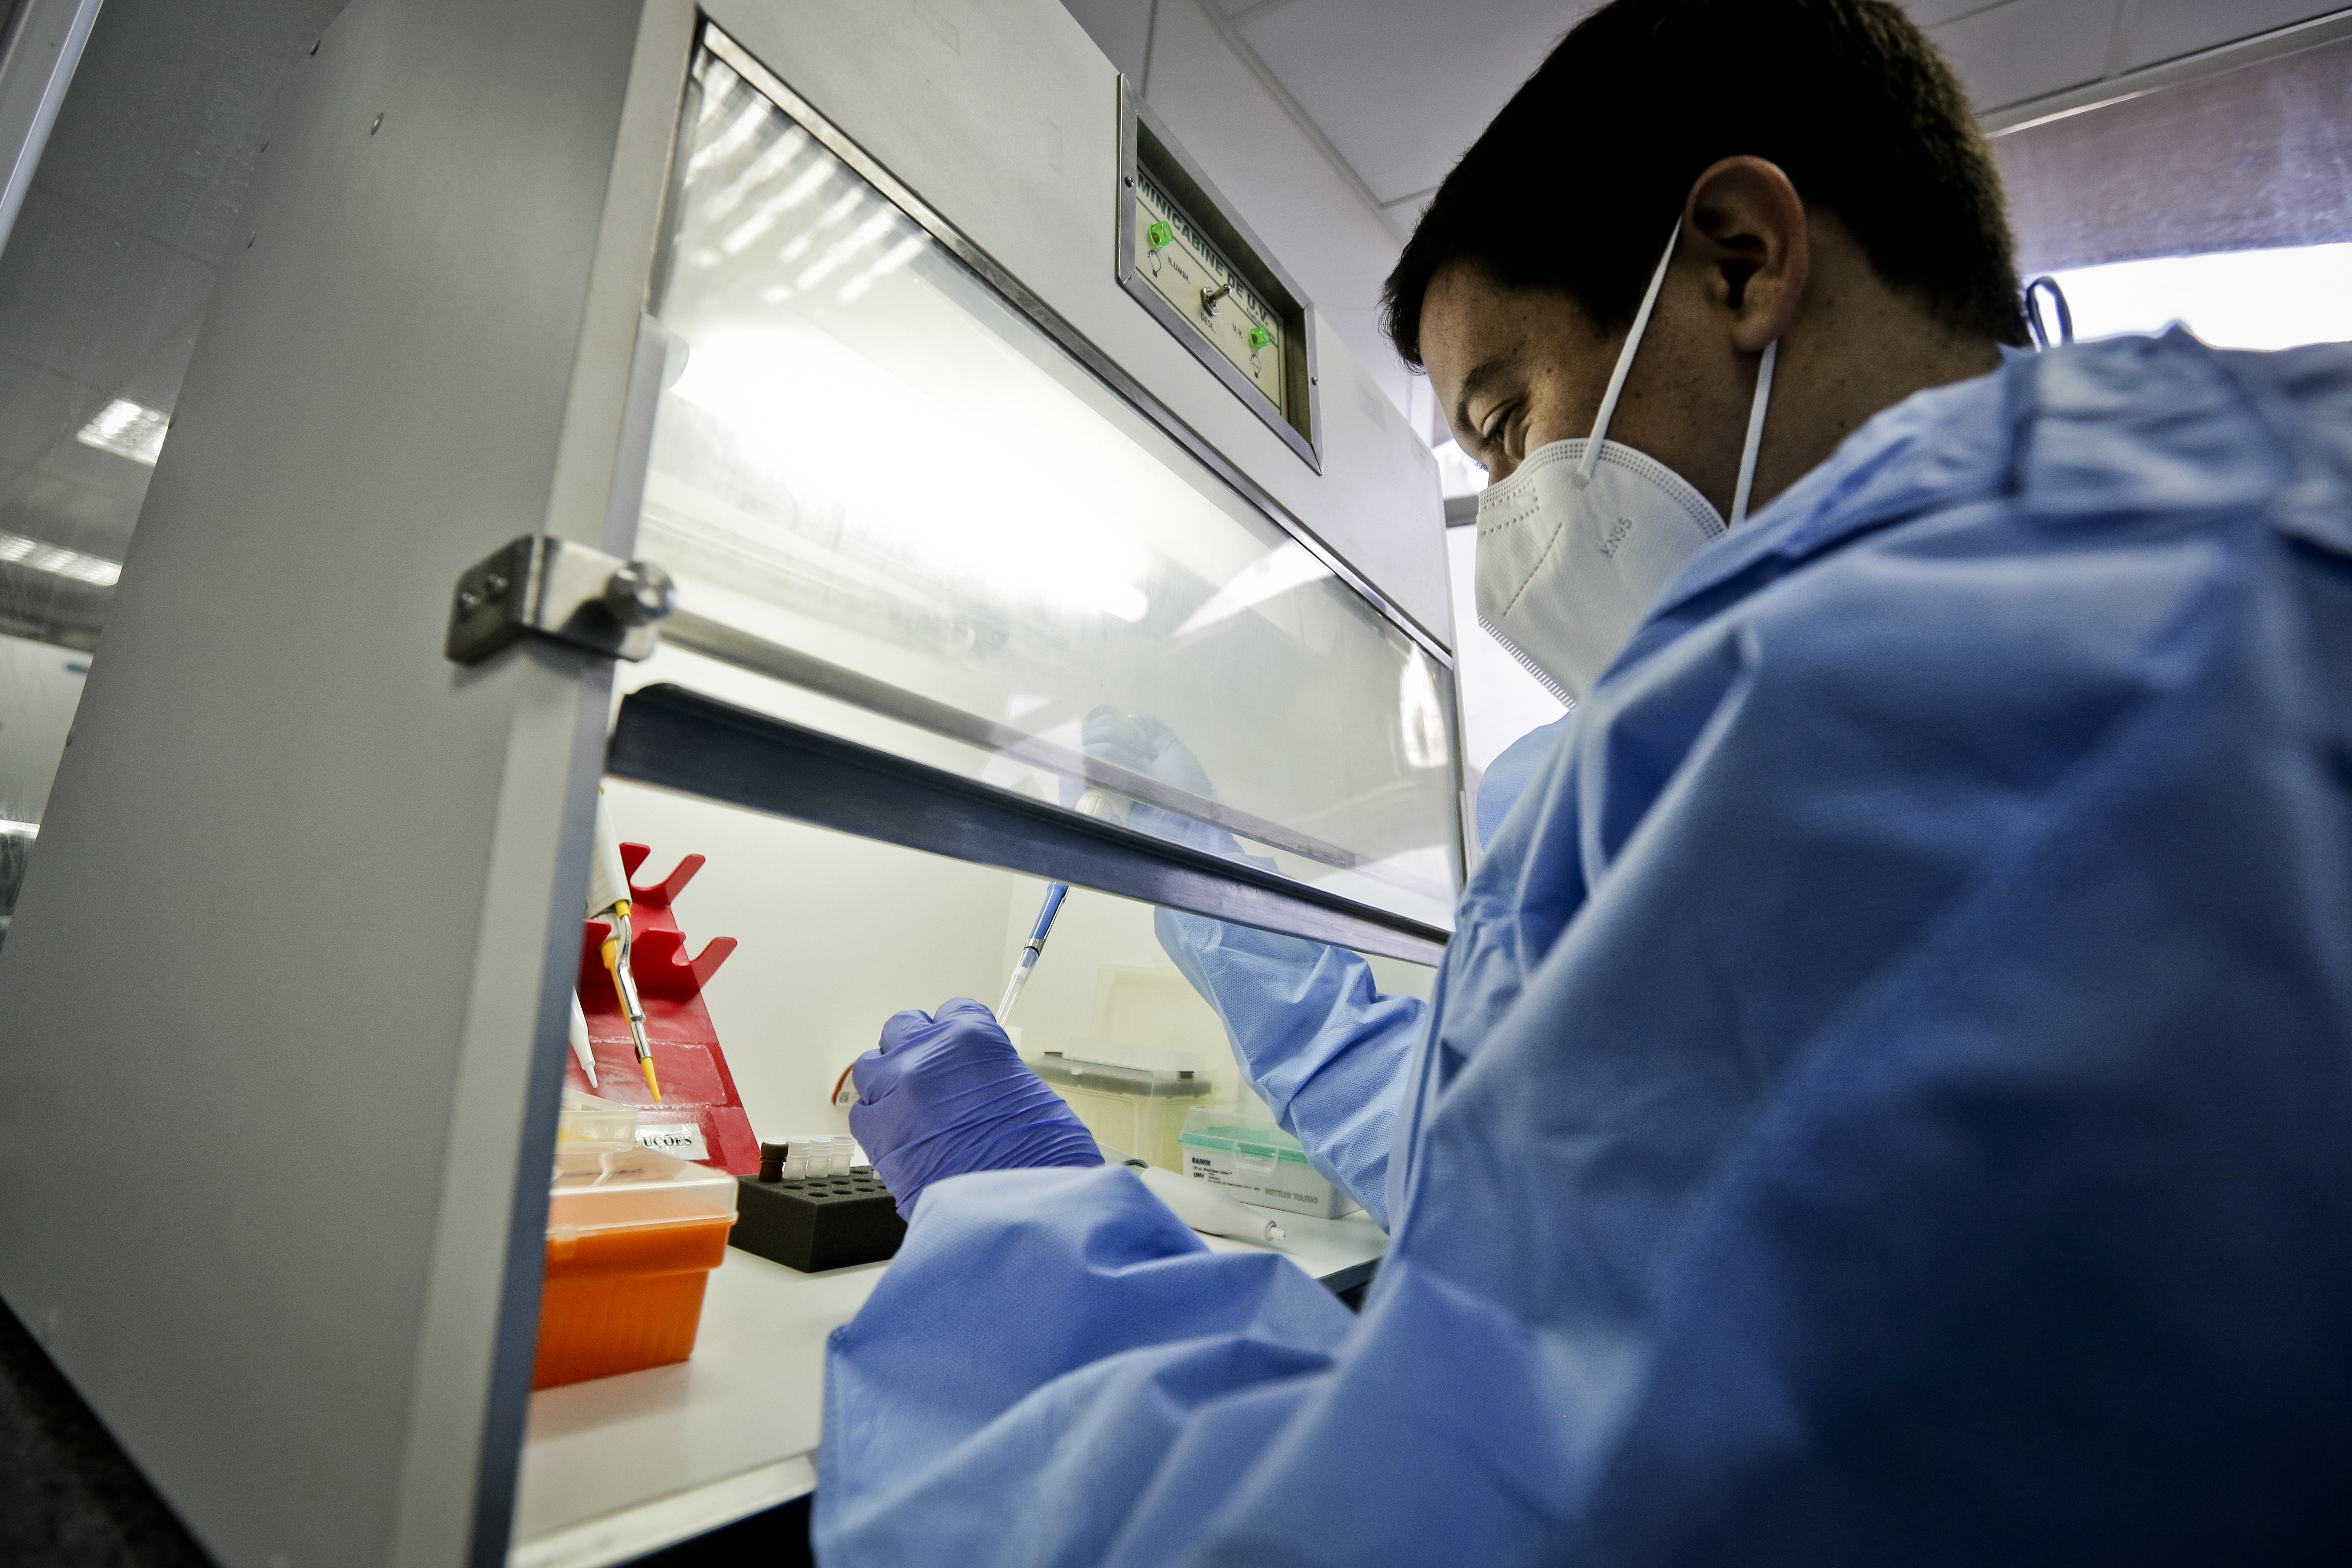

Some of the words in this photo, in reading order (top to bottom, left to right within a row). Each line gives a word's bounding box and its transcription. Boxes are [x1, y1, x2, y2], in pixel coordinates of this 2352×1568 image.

[1138, 174, 1223, 276] MINICABINE
[1227, 271, 1243, 299] DE
[1247, 293, 1268, 326] U.V.
[1168, 256, 1190, 284] ILUMIN.
[1201, 312, 1216, 333] DESL.
[1600, 517, 1633, 558] KN95
[642, 1134, 692, 1149] UÇÕES
[1192, 1157, 1211, 1166] RAININ
[1265, 1188, 1291, 1199] METTLER
[1294, 1193, 1318, 1204] TOLEDO
